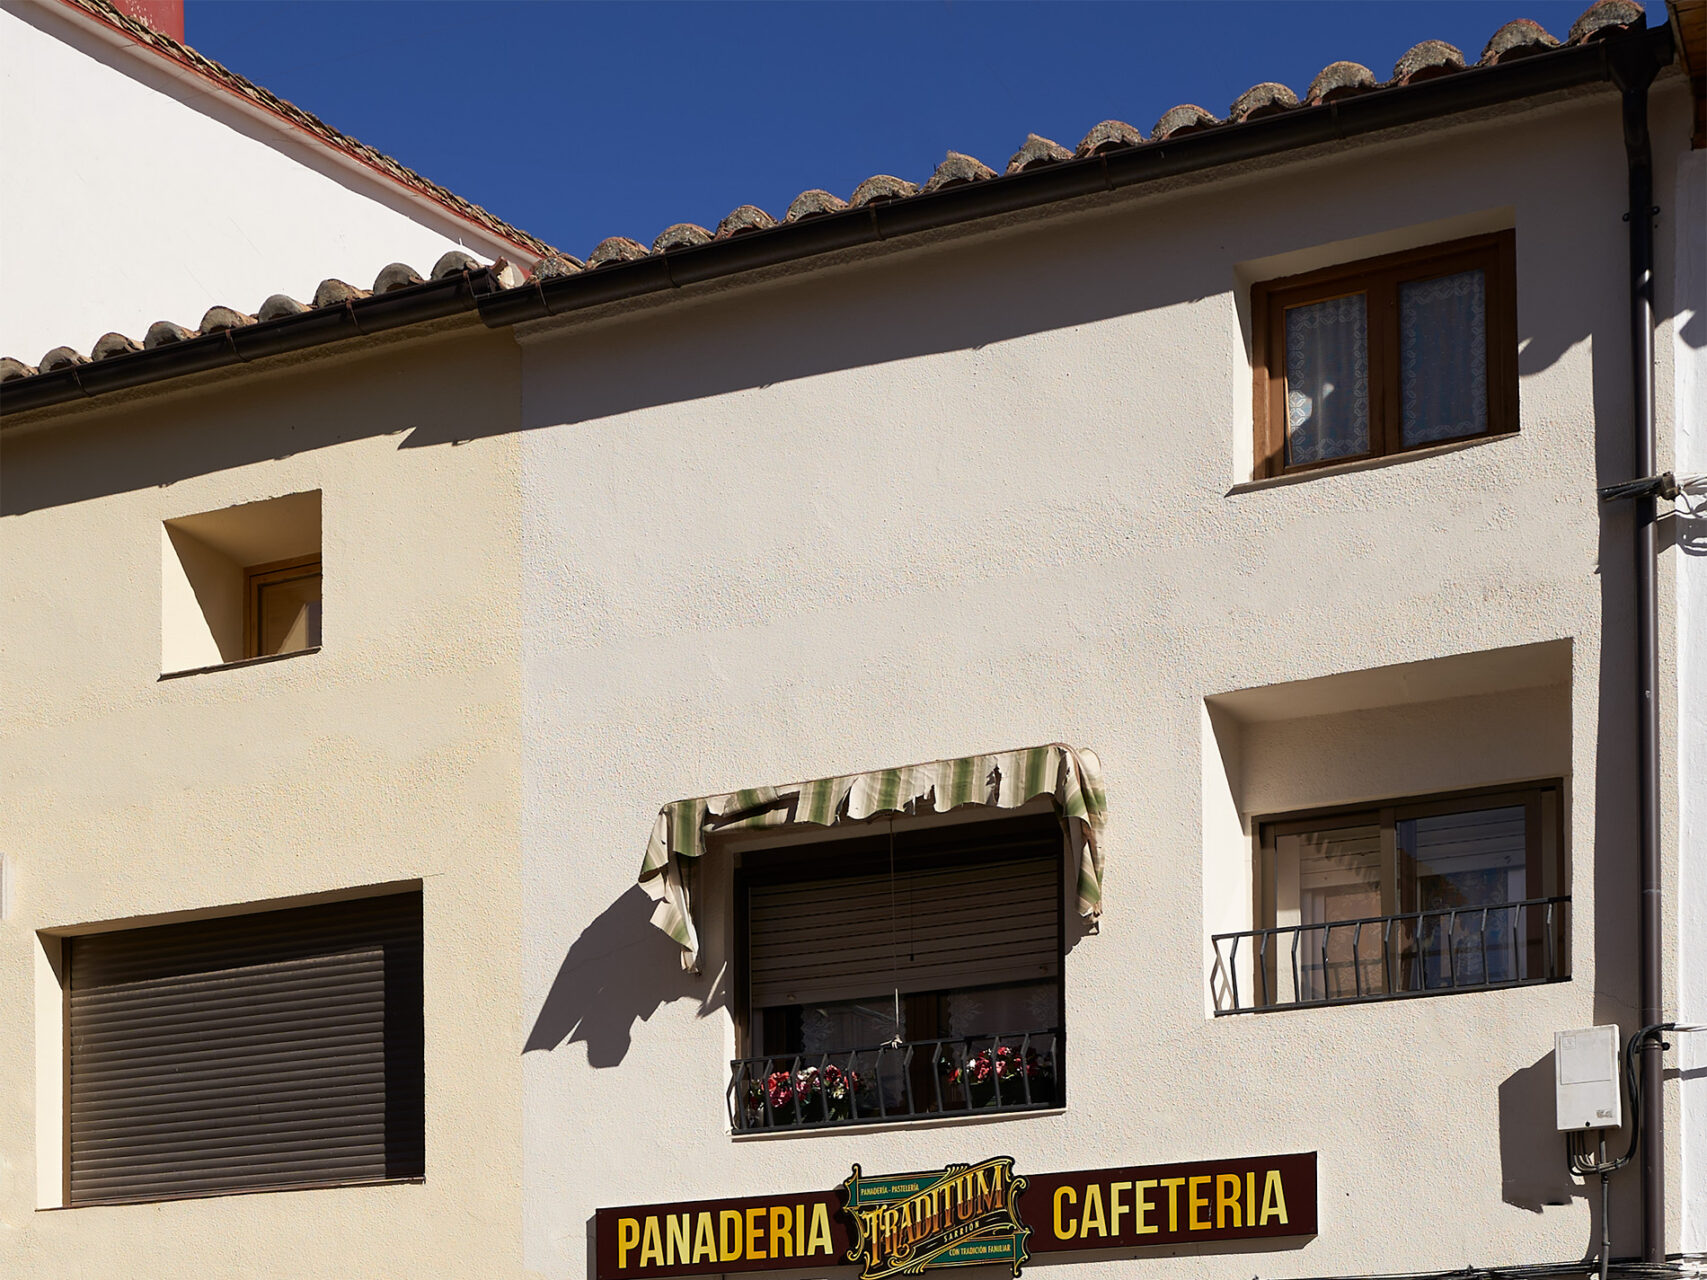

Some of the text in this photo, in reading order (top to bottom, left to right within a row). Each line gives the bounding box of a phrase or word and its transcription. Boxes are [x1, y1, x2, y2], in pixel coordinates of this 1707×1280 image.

[617, 1202, 834, 1269] PANADERIA
[861, 1165, 1004, 1269] TRADITUM
[1053, 1169, 1289, 1241] CAFETERIA
